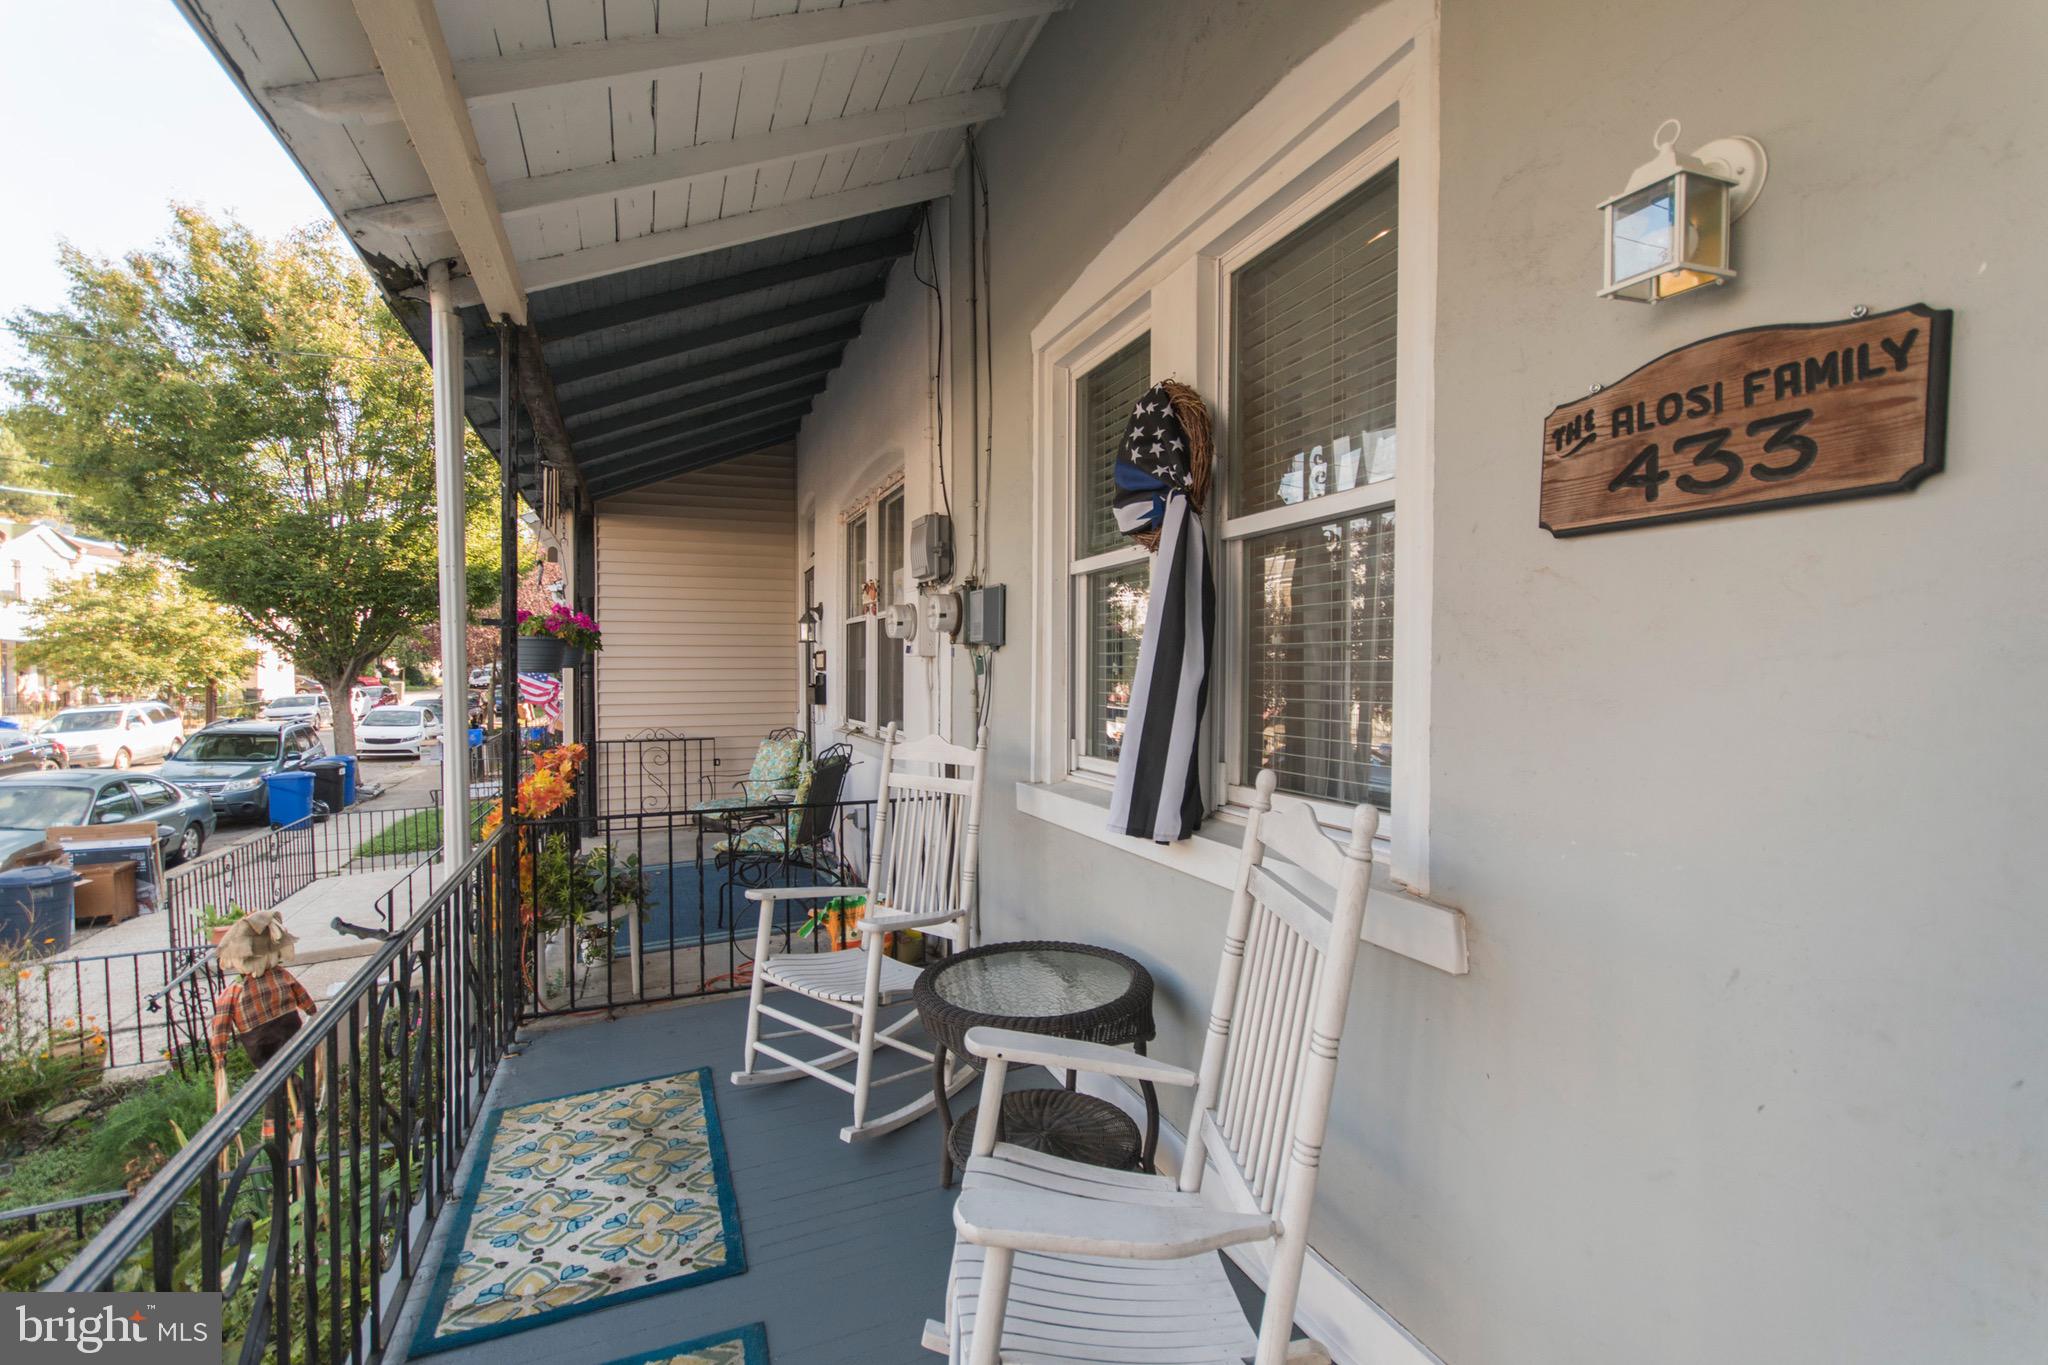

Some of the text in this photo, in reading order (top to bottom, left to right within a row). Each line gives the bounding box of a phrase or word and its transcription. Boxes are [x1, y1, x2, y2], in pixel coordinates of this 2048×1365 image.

[1551, 328, 1919, 452] THE ALOSI FAMILY
[1608, 408, 1818, 502] 433
